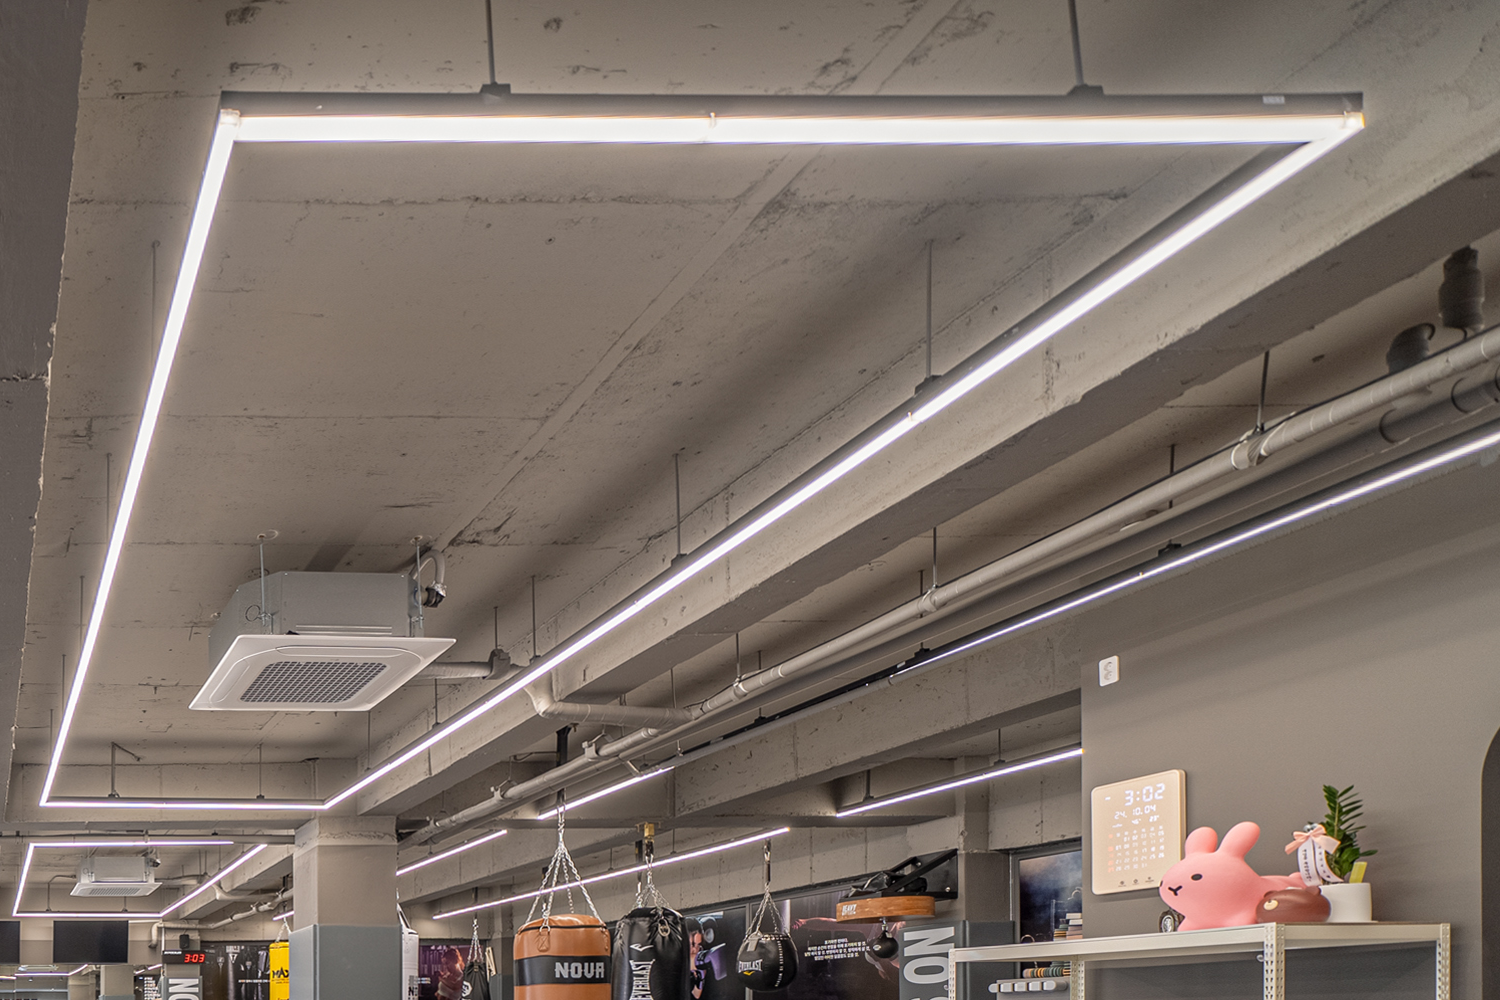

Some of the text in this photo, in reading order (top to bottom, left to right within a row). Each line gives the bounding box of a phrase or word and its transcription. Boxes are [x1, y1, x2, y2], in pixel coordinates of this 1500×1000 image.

[1124, 783, 1165, 806] 3:02
[184, 954, 205, 963] 3:03
[904, 926, 955, 985] NO
[629, 958, 656, 1000] EVERLAST
